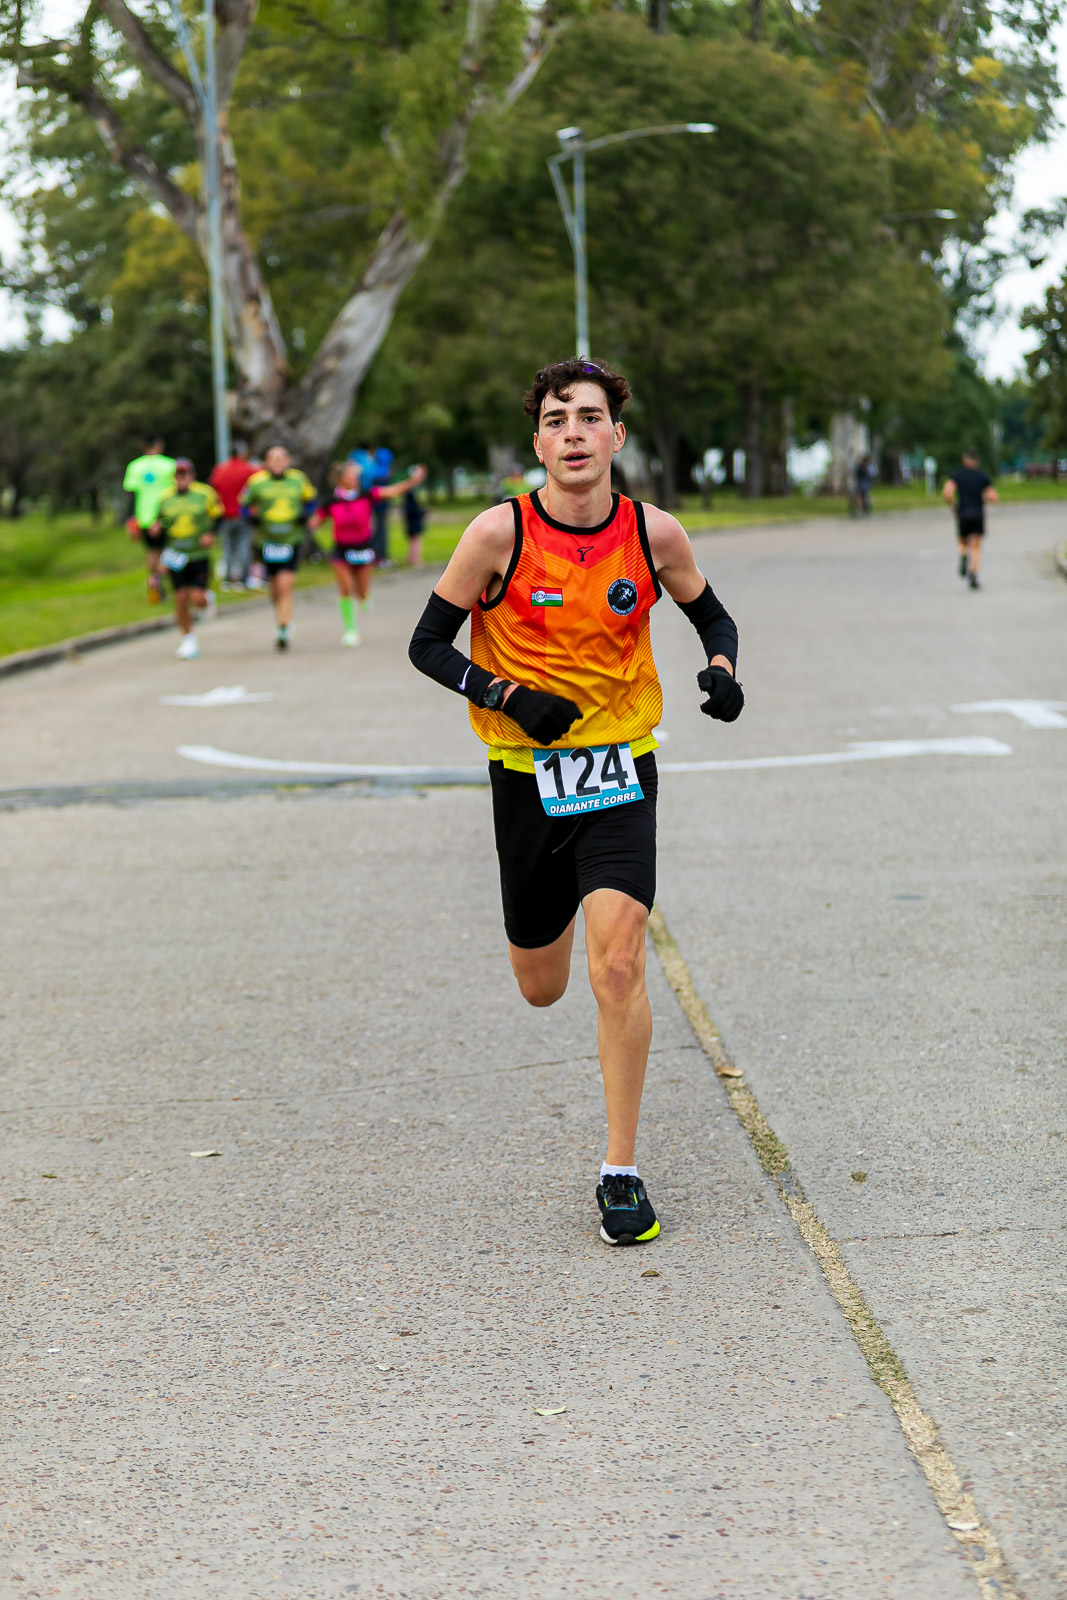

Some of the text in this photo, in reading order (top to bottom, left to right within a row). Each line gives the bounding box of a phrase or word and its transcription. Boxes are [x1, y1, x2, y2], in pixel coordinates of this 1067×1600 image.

[542, 743, 629, 800] 124
[550, 791, 637, 814] DIAMANTE CORRE
